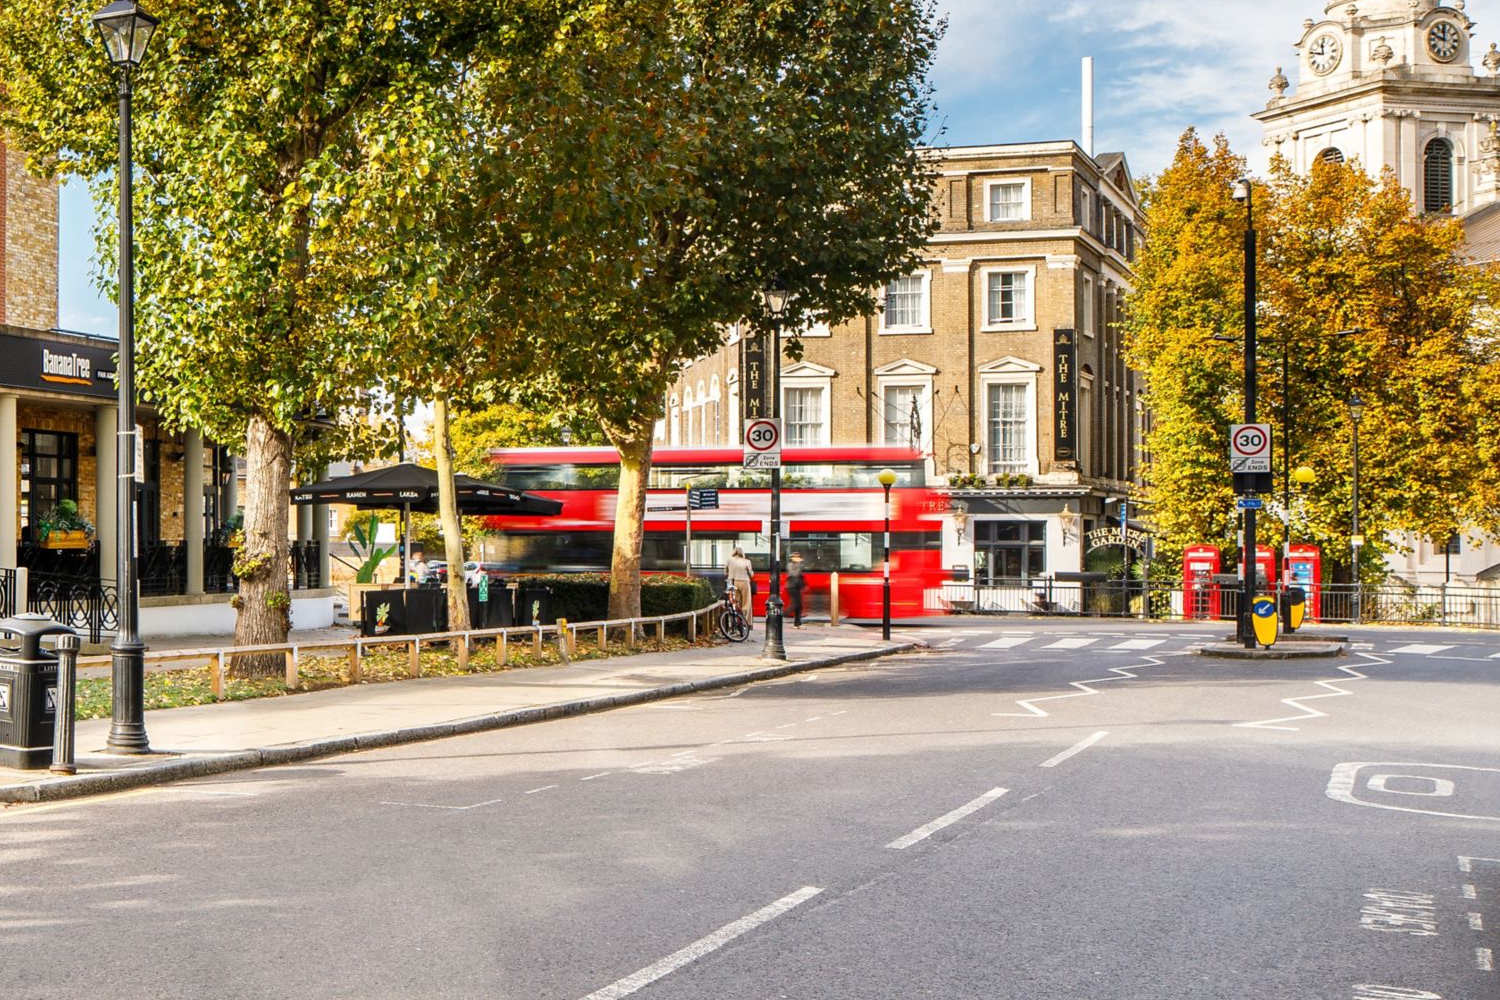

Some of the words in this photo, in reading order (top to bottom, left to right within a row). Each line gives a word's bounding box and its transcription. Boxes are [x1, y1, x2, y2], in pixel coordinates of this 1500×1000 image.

[43, 349, 90, 378] BananaTree
[750, 362, 759, 389] THE
[1058, 354, 1069, 383] THE
[1058, 392, 1069, 437] MITRE
[752, 429, 773, 442] 30
[1239, 435, 1262, 447] 30
[1086, 527, 1109, 540] THE
[1111, 526, 1146, 543] MTRE
